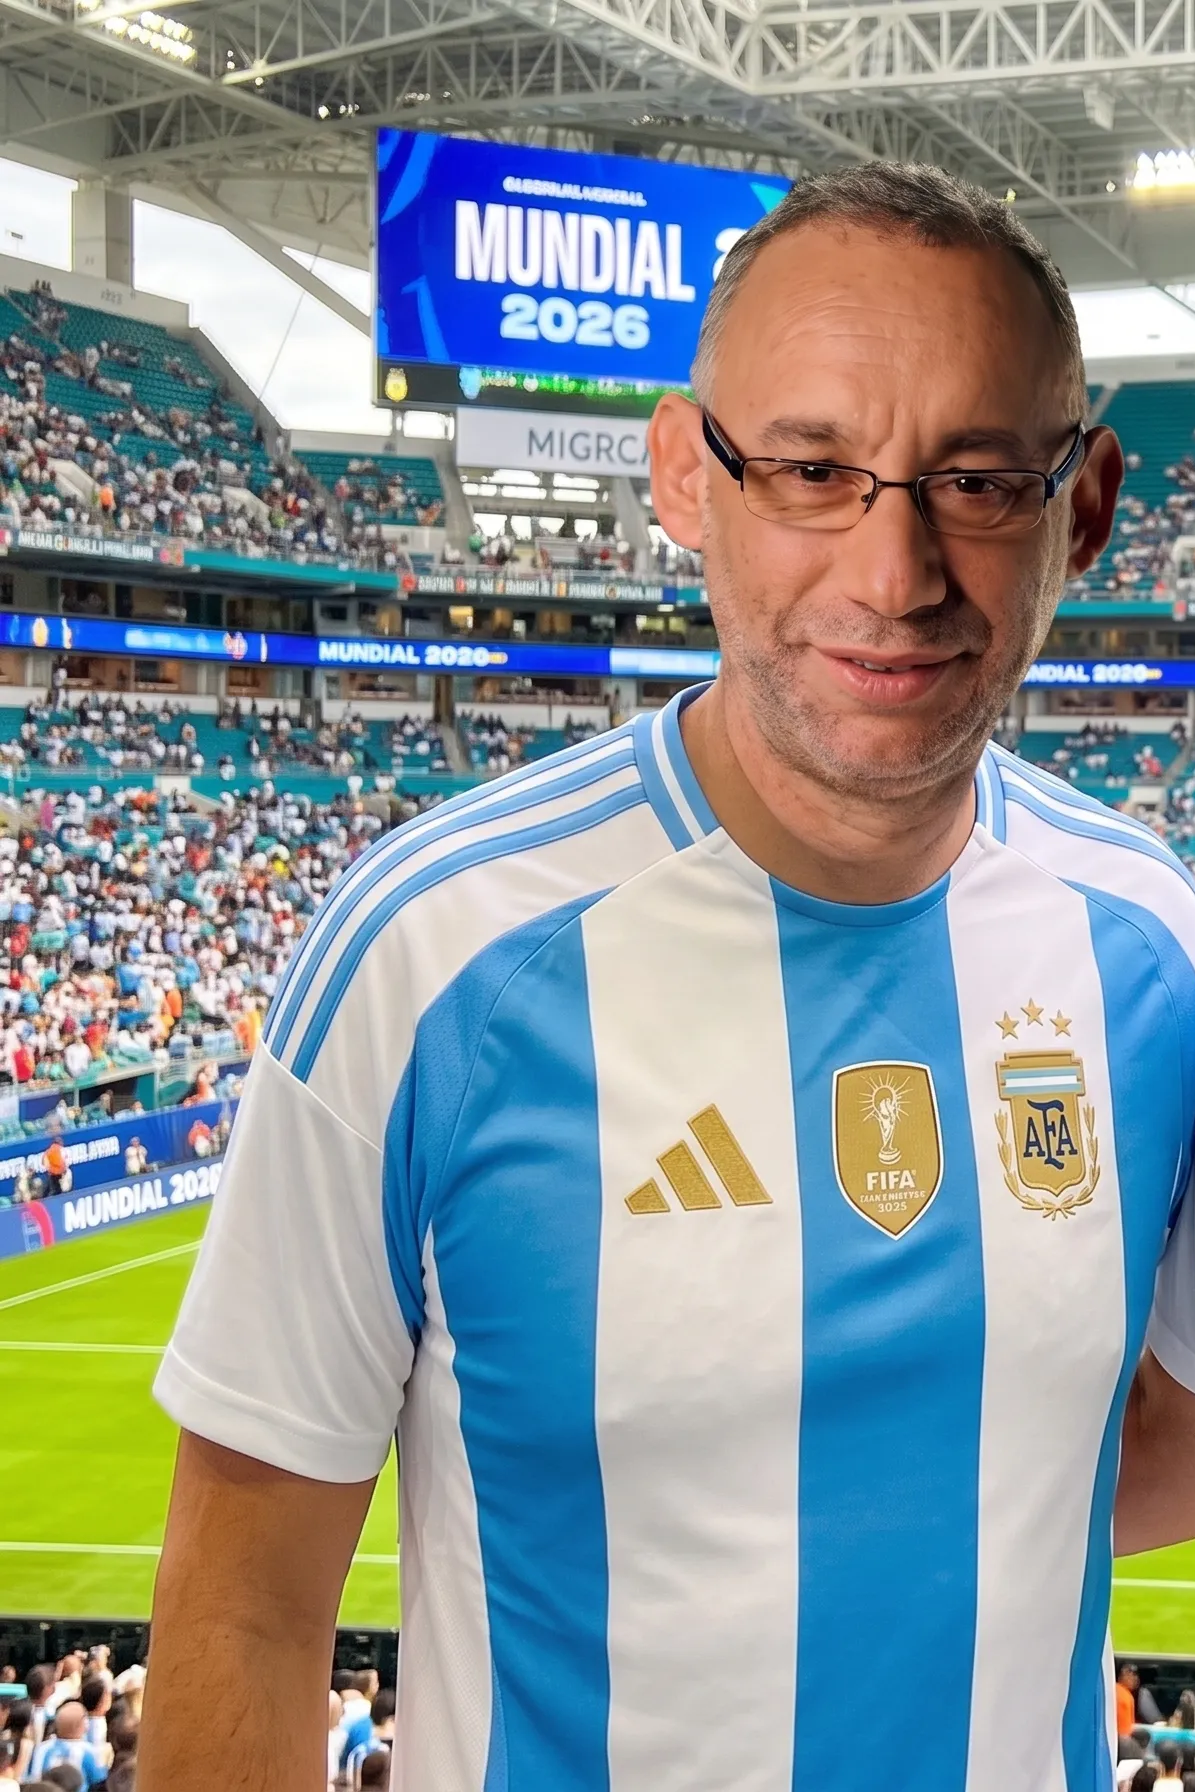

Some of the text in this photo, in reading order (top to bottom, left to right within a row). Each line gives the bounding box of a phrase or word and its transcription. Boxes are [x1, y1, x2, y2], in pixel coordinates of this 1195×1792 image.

[454, 199, 696, 301] MUNDIAL
[500, 293, 650, 349] 2026
[528, 428, 649, 465] MIGRC
[318, 641, 420, 664] MUNDIAL
[1023, 1099, 1078, 1170] AFA
[64, 1178, 168, 1233] MUNDIAL
[866, 1169, 916, 1191] FIFA
